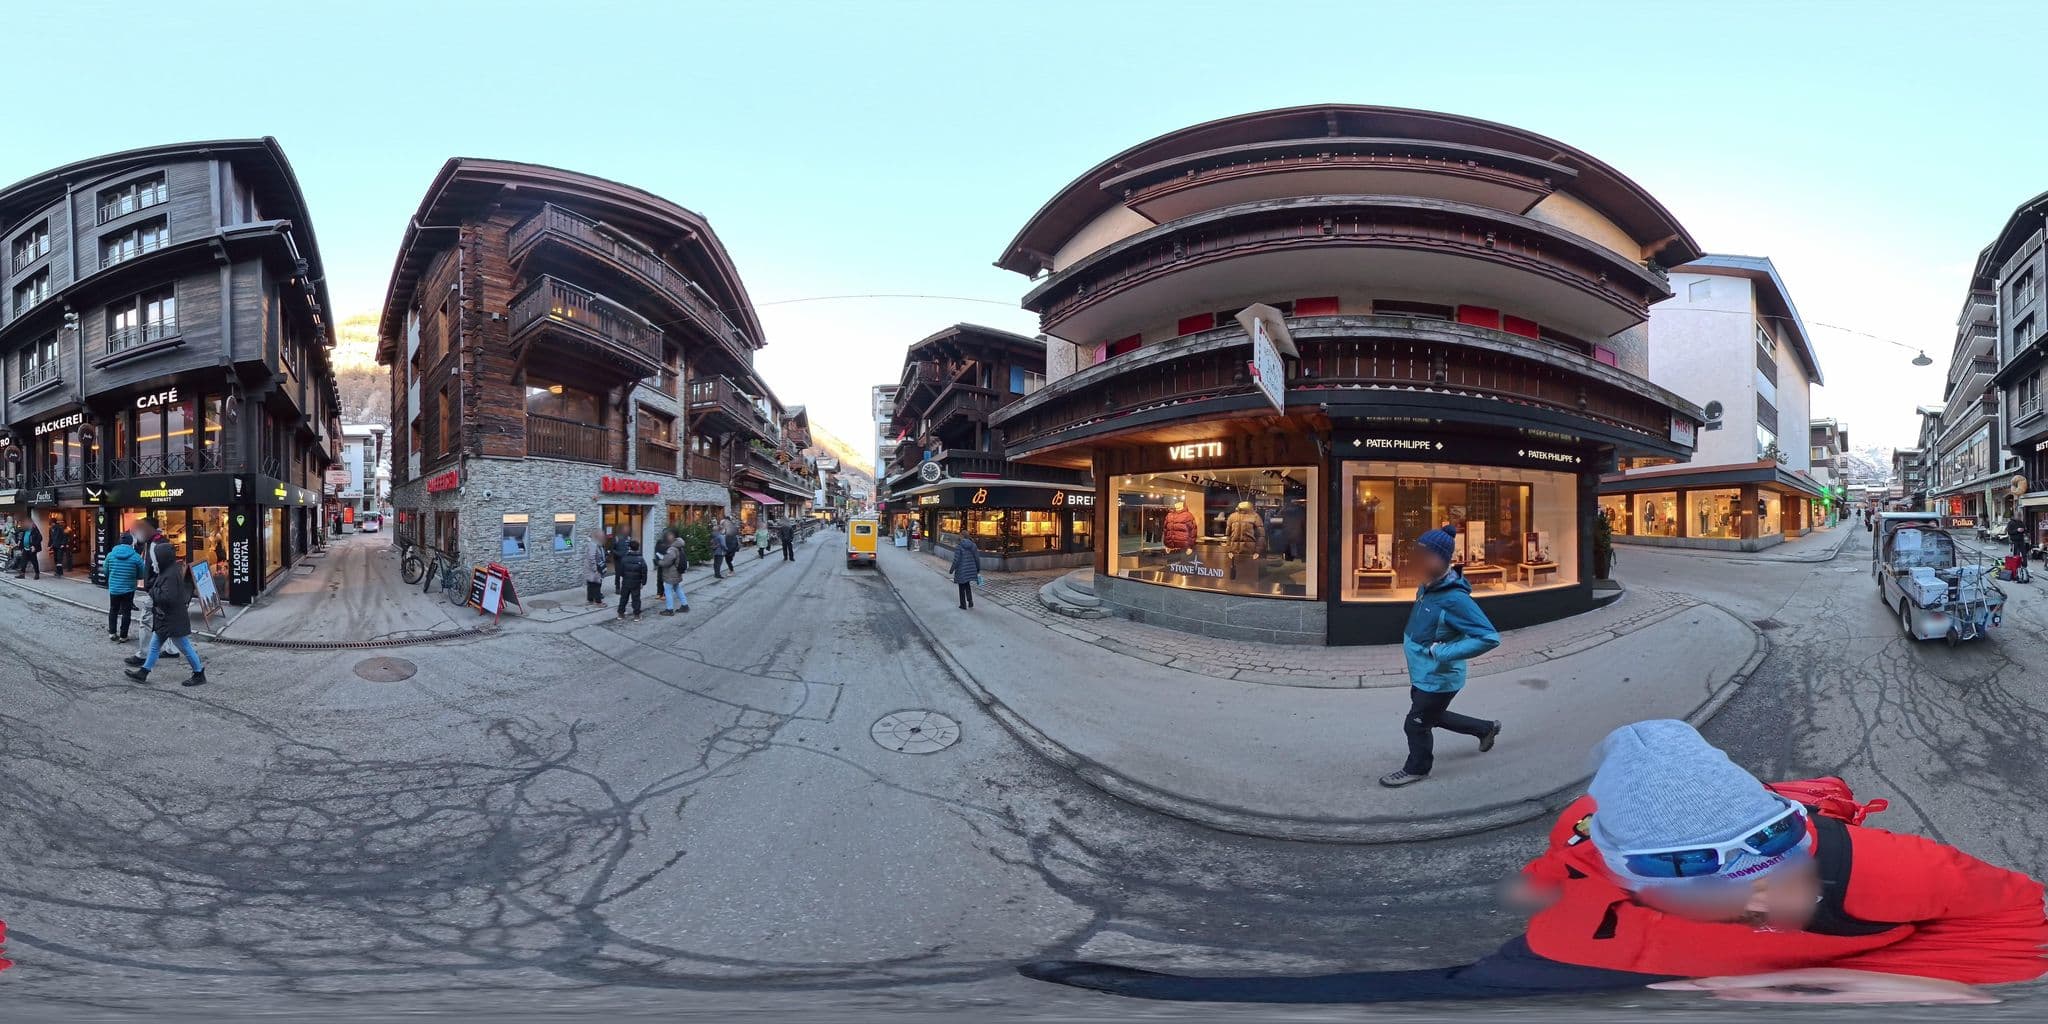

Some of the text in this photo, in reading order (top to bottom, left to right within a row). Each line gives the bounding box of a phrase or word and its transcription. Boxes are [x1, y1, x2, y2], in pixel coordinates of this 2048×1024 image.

[137, 387, 178, 408] CAFÉ
[35, 412, 83, 436] BÄCKEREI
[1169, 442, 1222, 460] VIETTI
[1366, 439, 1430, 450] PATEK PHILIPPE
[1528, 450, 1573, 463] PATEK PHILIPPE
[1952, 518, 1974, 527] Pollux
[233, 541, 241, 576] FLOORS
[241, 538, 249, 573] RENTAL
[1169, 563, 1224, 577] STONE ISLAND
